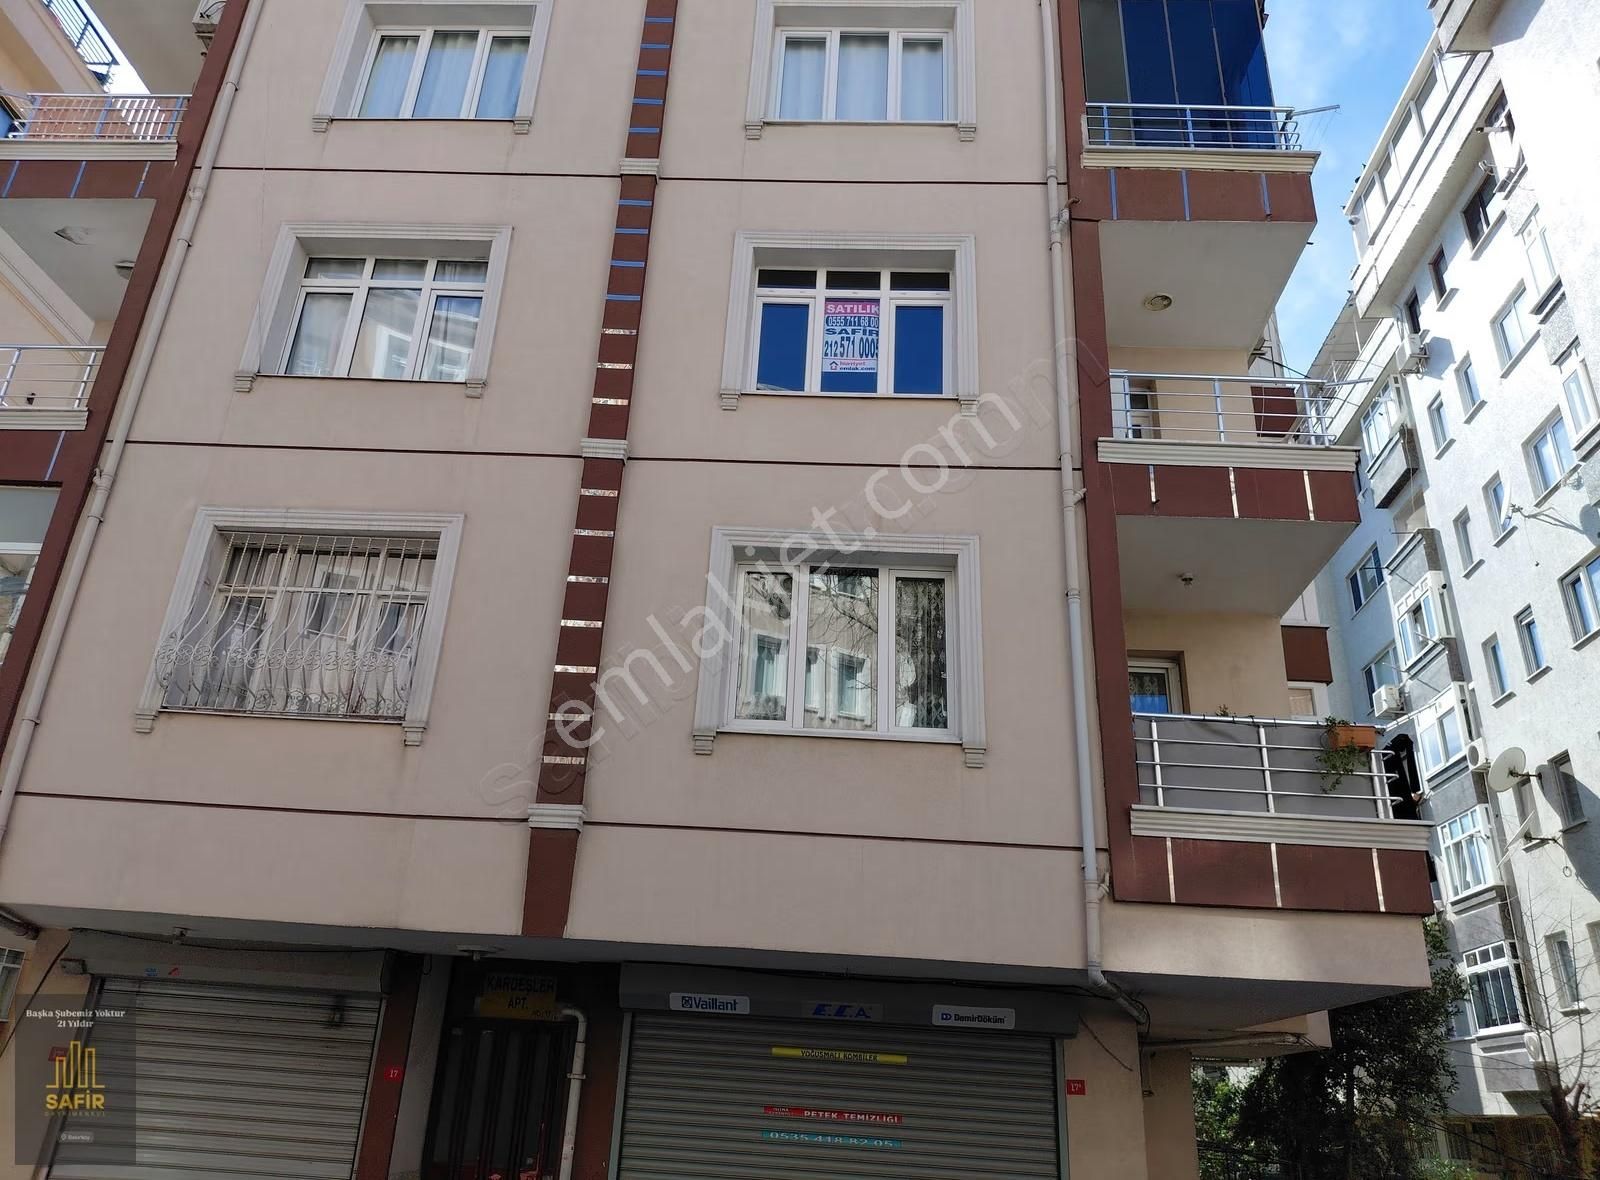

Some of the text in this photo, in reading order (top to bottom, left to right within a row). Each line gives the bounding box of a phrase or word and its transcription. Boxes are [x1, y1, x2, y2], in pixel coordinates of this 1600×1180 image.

[827, 304, 879, 314] SATILIK
[828, 316, 879, 327] 0555 711 68 00
[824, 340, 839, 358] 212
[839, 336, 856, 358] 571
[693, 996, 739, 1012] Vaillant
[389, 1068, 399, 1078] 17
[803, 1110, 838, 1120] PETEK
[769, 1131, 809, 1142] 0535
[814, 1134, 843, 1144] 418
[872, 1138, 894, 1147] 05
